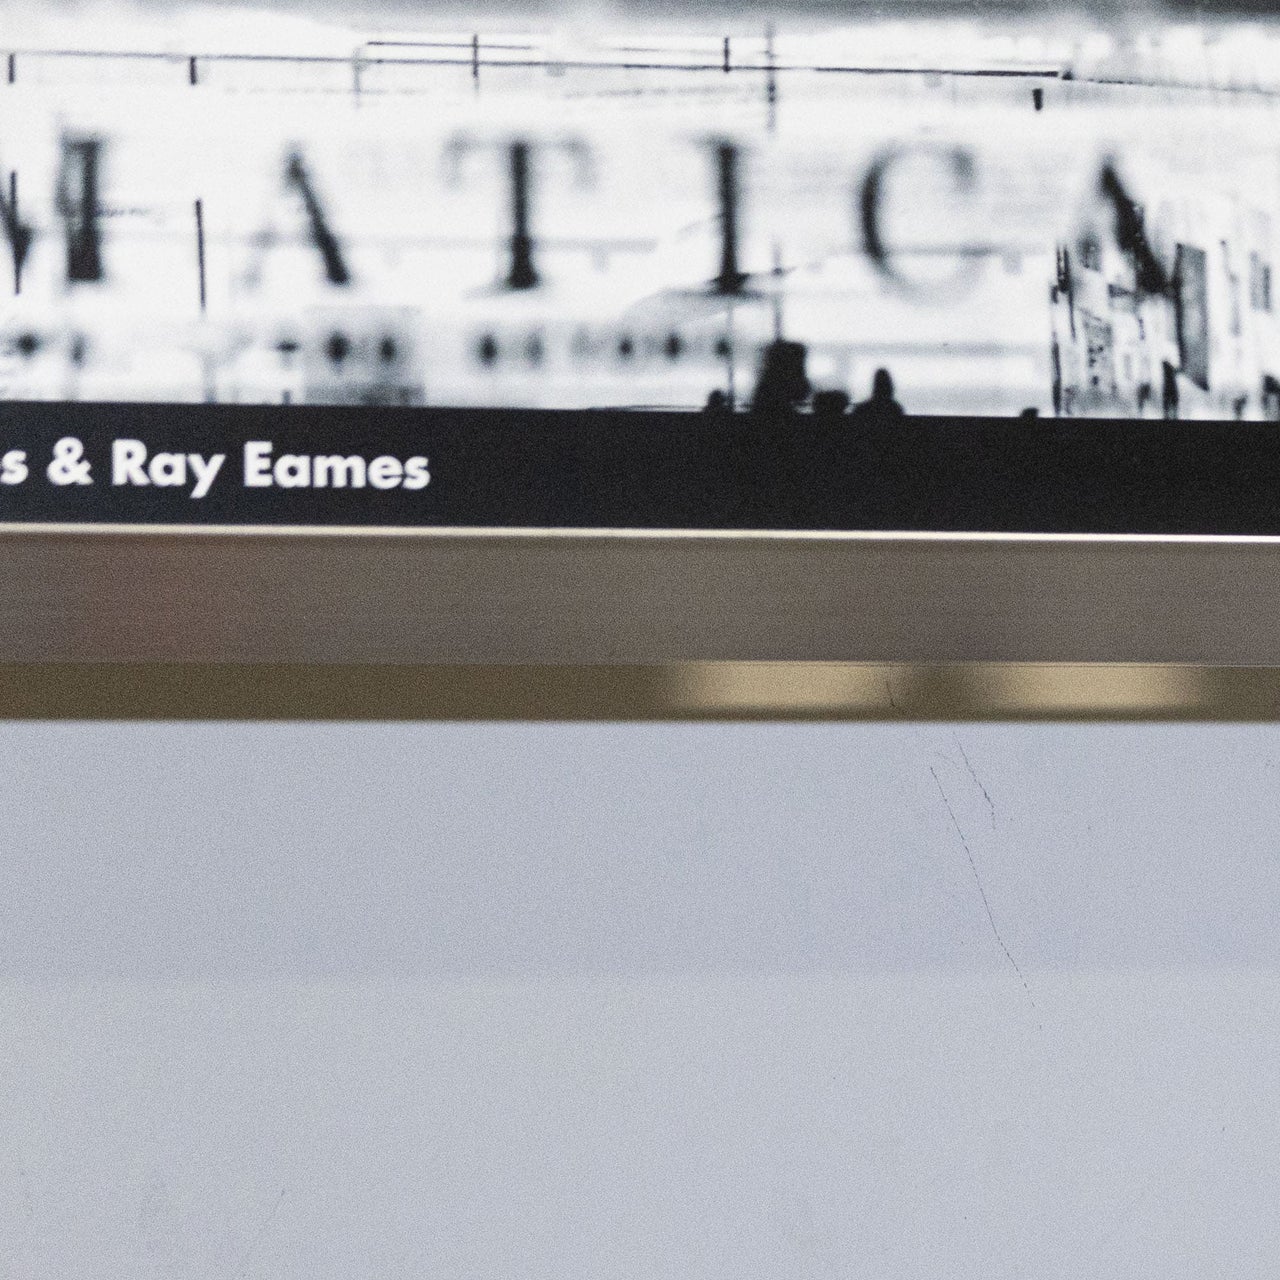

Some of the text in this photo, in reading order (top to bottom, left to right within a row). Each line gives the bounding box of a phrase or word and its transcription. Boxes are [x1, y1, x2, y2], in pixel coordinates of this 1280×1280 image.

[47, 437, 430, 498] & Ray Eames
